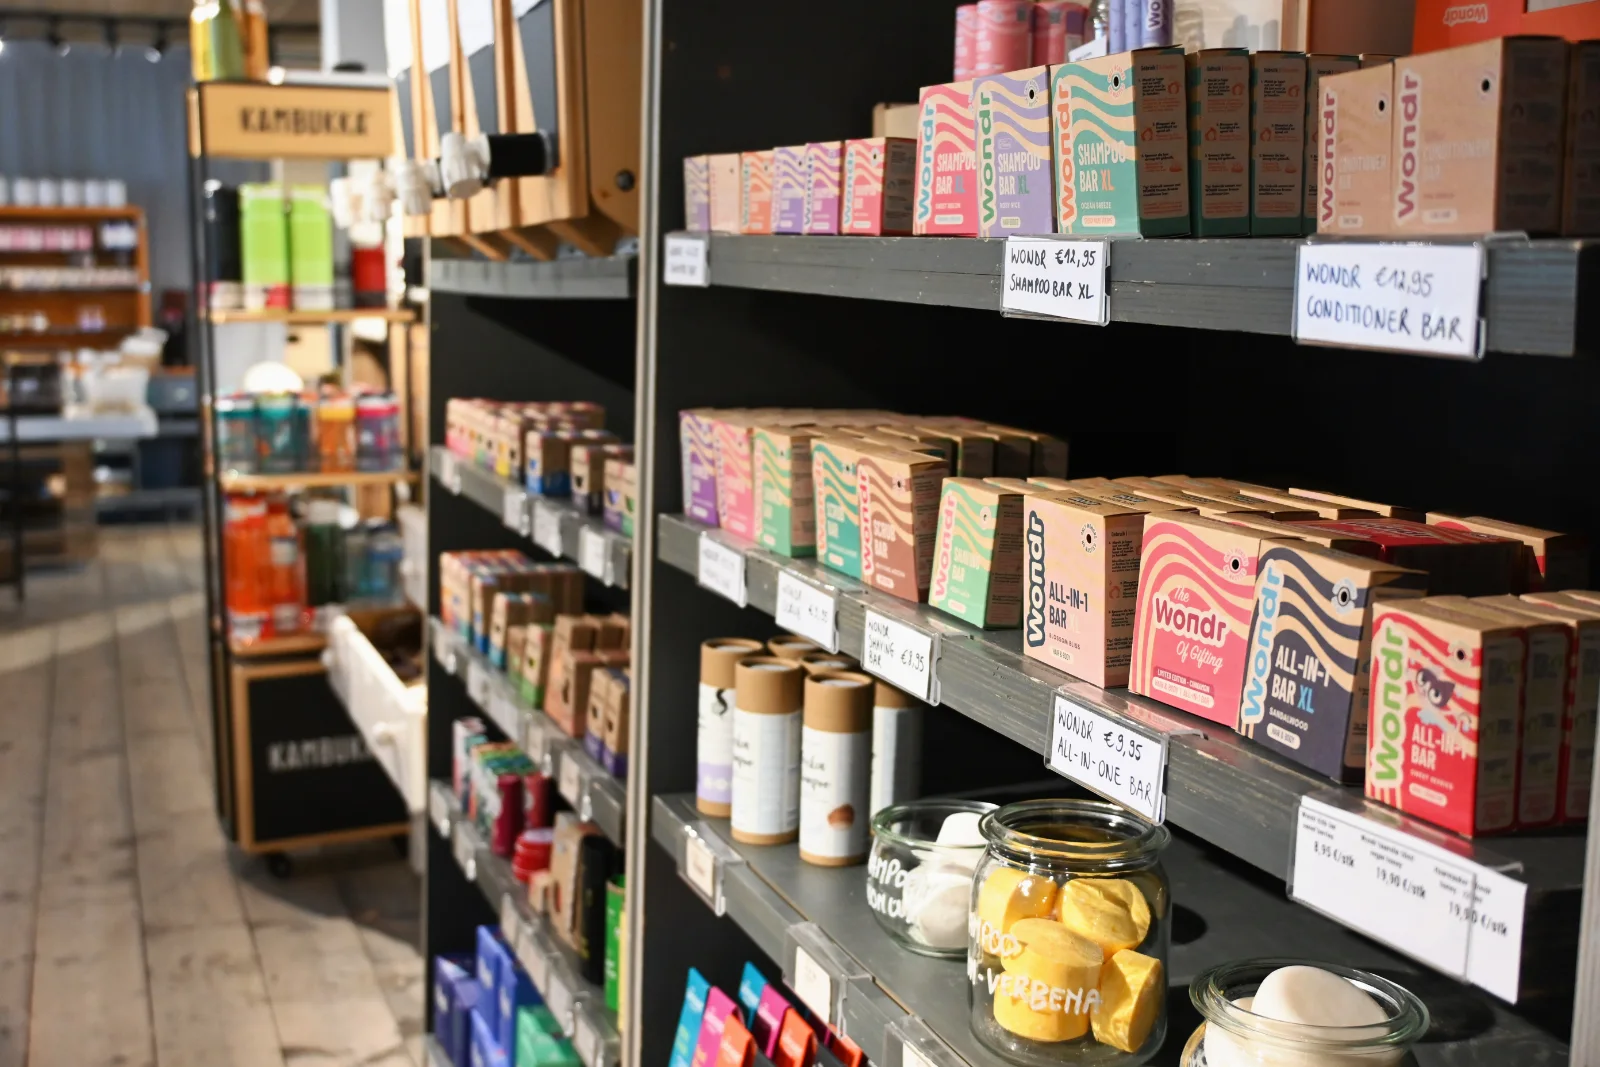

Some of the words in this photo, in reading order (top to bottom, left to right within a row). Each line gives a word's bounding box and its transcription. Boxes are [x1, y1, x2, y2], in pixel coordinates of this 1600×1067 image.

[240, 106, 371, 136] KAMBUKKA
[918, 104, 934, 220] wondr
[979, 92, 994, 223] wondr
[998, 152, 1041, 172] SHAMPOO
[1057, 85, 1074, 221] wondr
[1078, 140, 1126, 166] SHAMPOO
[1322, 93, 1335, 223] wondr
[1398, 75, 1418, 218] wondr
[936, 176, 952, 195] BAR
[999, 176, 1016, 195] BAR
[1018, 175, 1030, 194] XL
[1080, 170, 1098, 192] BAR
[1101, 169, 1114, 191] XL
[1011, 248, 1046, 269] WONDR
[1055, 248, 1096, 268] €12,95
[1010, 274, 1050, 294] SHAMPOO
[1052, 281, 1073, 297] BAR
[1078, 282, 1094, 300] XL
[1307, 262, 1361, 289] WONDR
[1375, 266, 1433, 297] €12,95
[1307, 295, 1411, 335] CONDITIONER
[1421, 312, 1463, 342] BAR
[935, 496, 955, 596] wondr
[1028, 513, 1044, 643] wondr
[1173, 586, 1189, 602] The
[1049, 581, 1088, 612] ALL-IN-1
[1049, 605, 1067, 629] BAR
[1155, 597, 1227, 642] Wondr
[869, 650, 881, 668] BAR
[1176, 640, 1188, 664] Of
[1190, 645, 1223, 675] Gifting
[1245, 567, 1282, 717] wondr
[1275, 645, 1332, 687] ALL-IN-1
[1271, 674, 1296, 706] BAR
[1297, 684, 1314, 714] XL
[1375, 627, 1403, 780] wondr
[1058, 706, 1094, 742] WONDR
[1104, 731, 1143, 761] €9,95
[1269, 707, 1308, 731] SANDALWOOD
[267, 737, 371, 773] KAMBUK
[1058, 737, 1121, 785] ALL-IN-ONE
[1129, 776, 1152, 807] BAR
[1411, 744, 1436, 771] BAR
[1314, 841, 1331, 858] 8,95
[1377, 866, 1400, 887] 19,90
